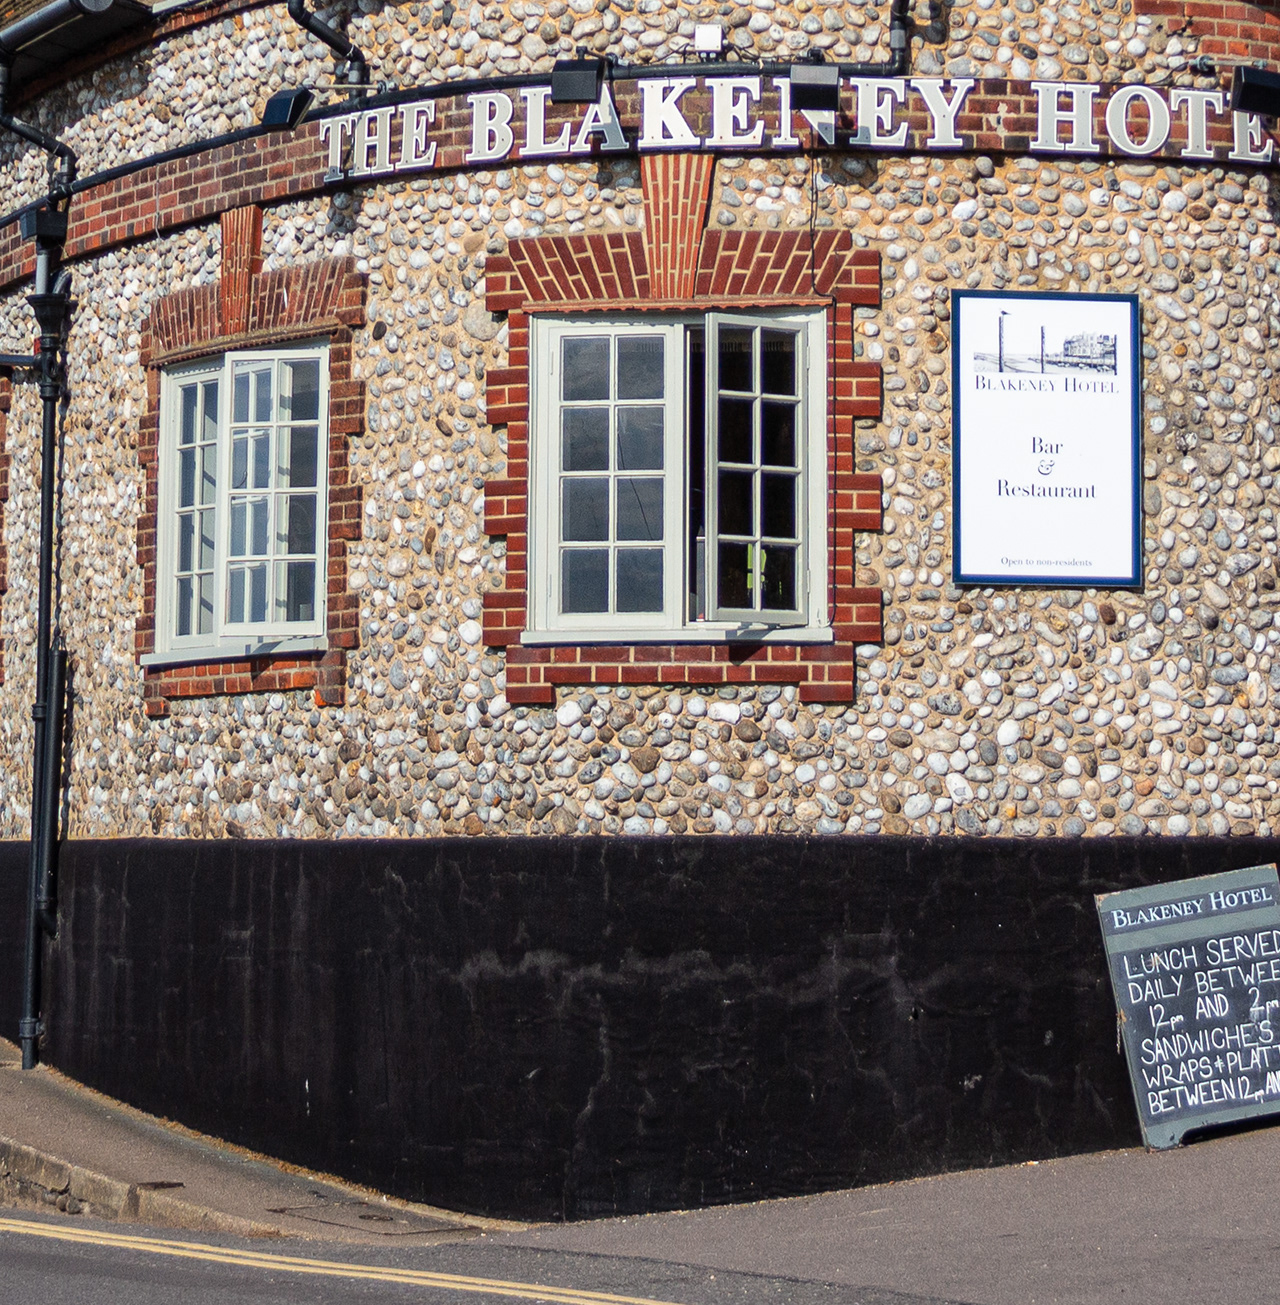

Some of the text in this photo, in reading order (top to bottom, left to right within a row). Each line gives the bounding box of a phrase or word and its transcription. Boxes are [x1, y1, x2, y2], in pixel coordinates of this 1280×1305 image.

[319, 99, 437, 182] THE
[465, 78, 975, 163] BLAKENEY
[975, 375, 1119, 394] BLAKENEY HOTEL
[1032, 437, 1064, 454] Bar
[1037, 460, 1055, 476] &
[997, 479, 1097, 499] Restaurant
[1001, 557, 1023, 567] Open
[1036, 558, 1093, 566] non-residents
[1111, 887, 1273, 929] BLAKENEY HOTEL
[1123, 945, 1197, 980] LUNCH
[1128, 974, 1183, 1004] DAILY
[1149, 1003, 1184, 1031] 12pm
[1195, 993, 1229, 1020] AND
[1142, 1056, 1213, 1089] WRAPS
[1148, 1078, 1236, 1115] BETWEEN
